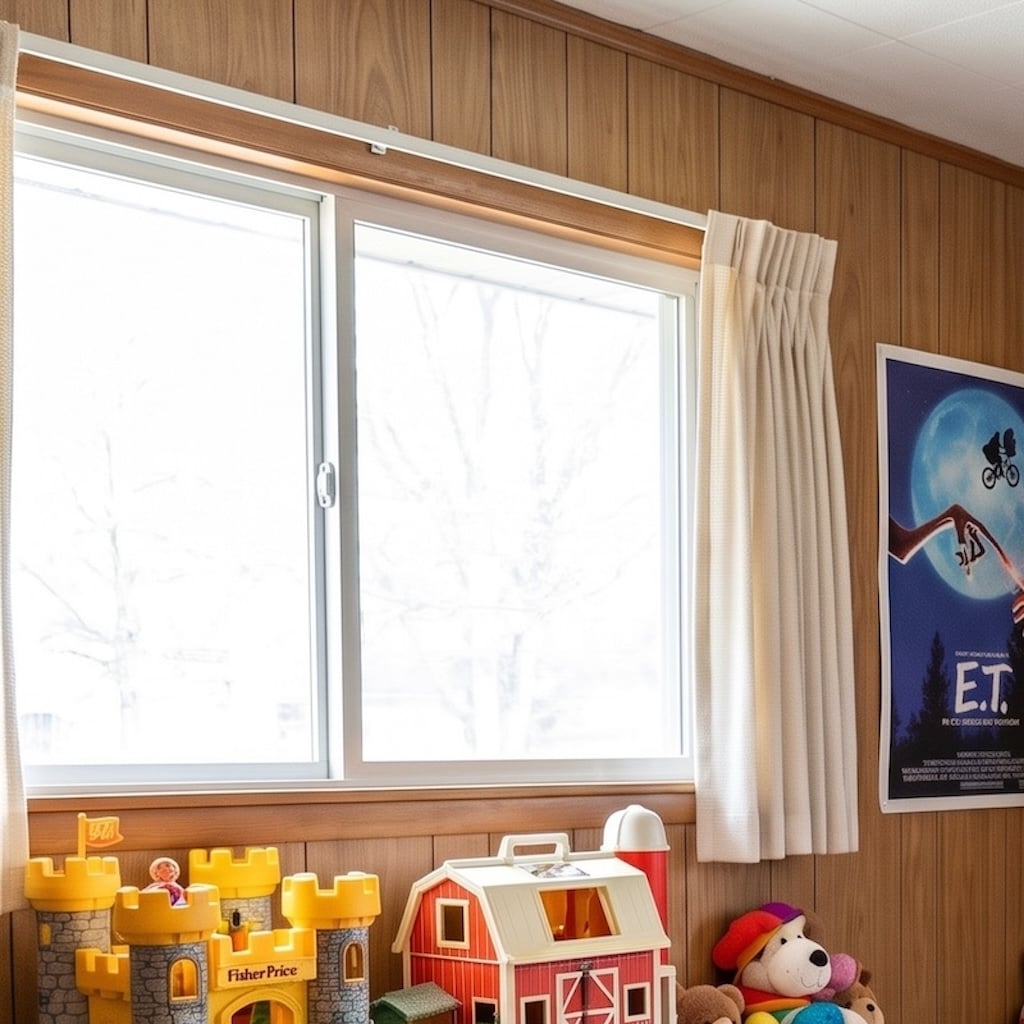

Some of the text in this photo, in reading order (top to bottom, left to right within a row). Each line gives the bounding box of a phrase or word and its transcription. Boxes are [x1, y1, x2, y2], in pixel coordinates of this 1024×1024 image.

[955, 661, 1013, 714] E.T.
[227, 965, 298, 982] Fisher Price
